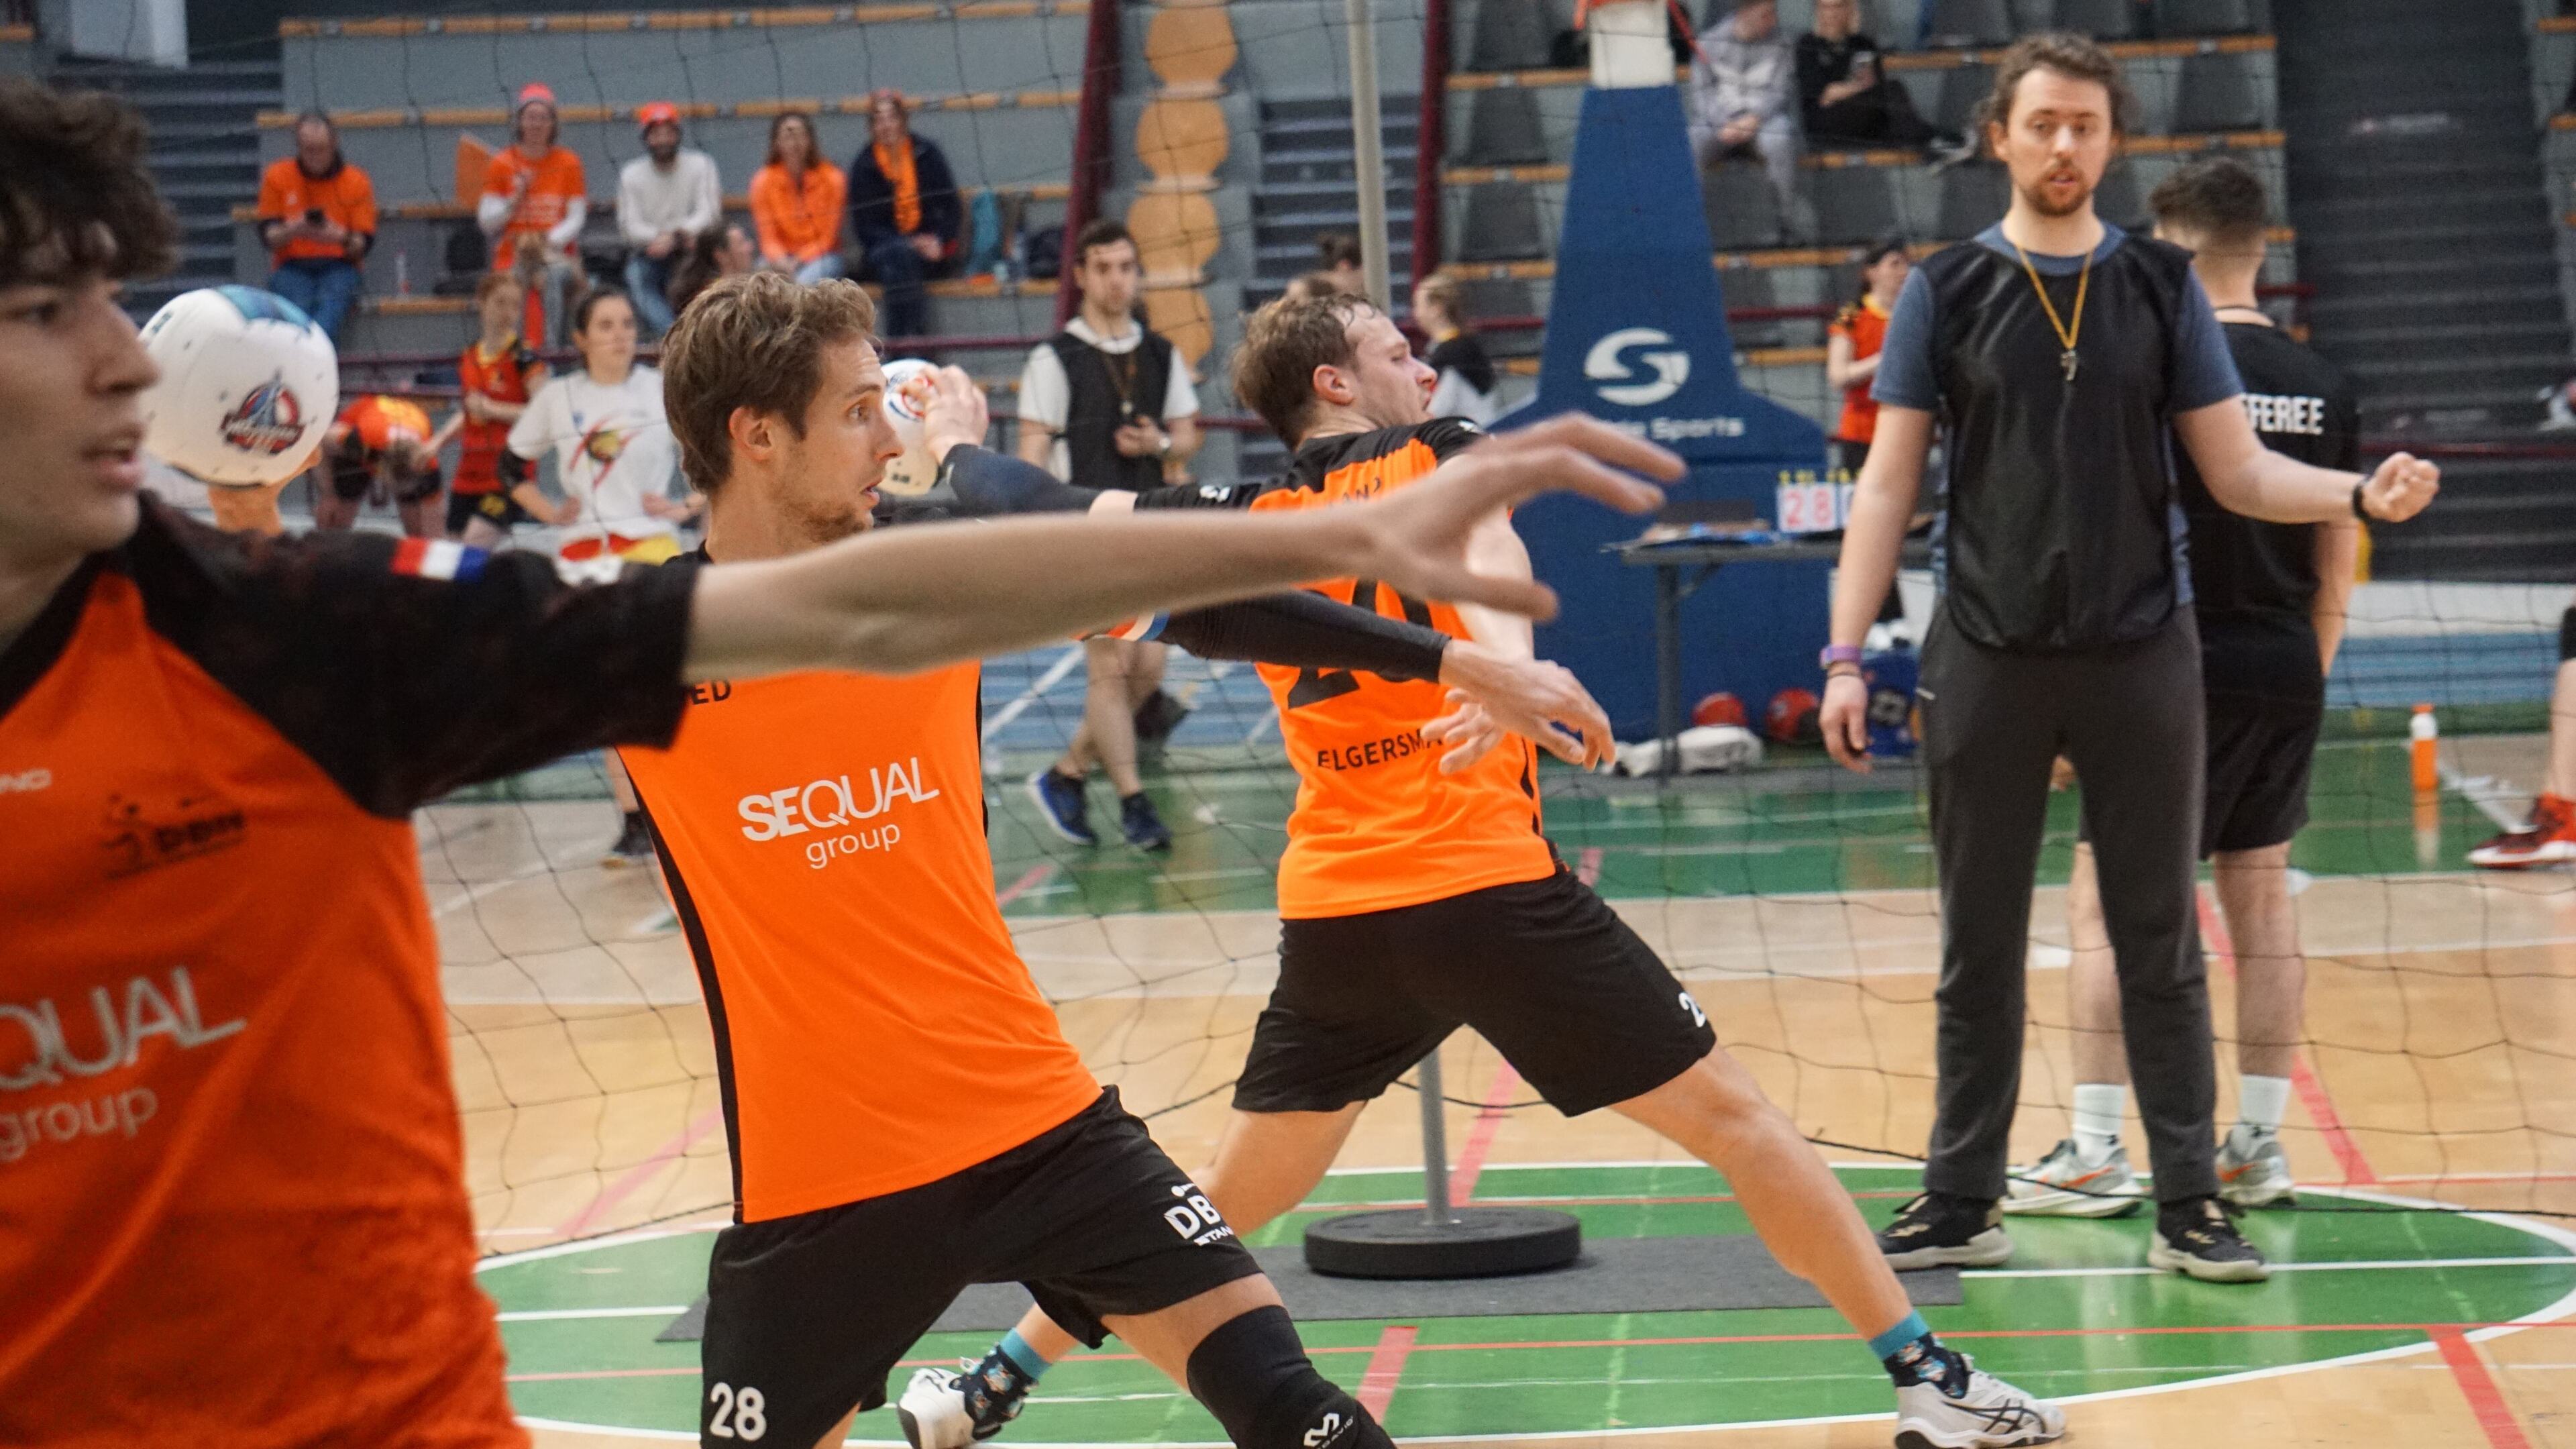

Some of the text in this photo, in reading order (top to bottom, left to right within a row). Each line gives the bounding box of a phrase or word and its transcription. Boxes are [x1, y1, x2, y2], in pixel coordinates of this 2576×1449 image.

[2239, 393, 2324, 435] FEREE
[690, 679, 731, 705] ED
[738, 757, 940, 842] SEQUAL
[806, 823, 900, 869] group
[0, 965, 248, 1089] QUAL
[1678, 992, 1706, 1028] 2
[0, 1087, 158, 1163] group
[1163, 1195, 1221, 1240] DB
[710, 1382, 767, 1442] 28
[1316, 1416, 1354, 1449] DAVID
